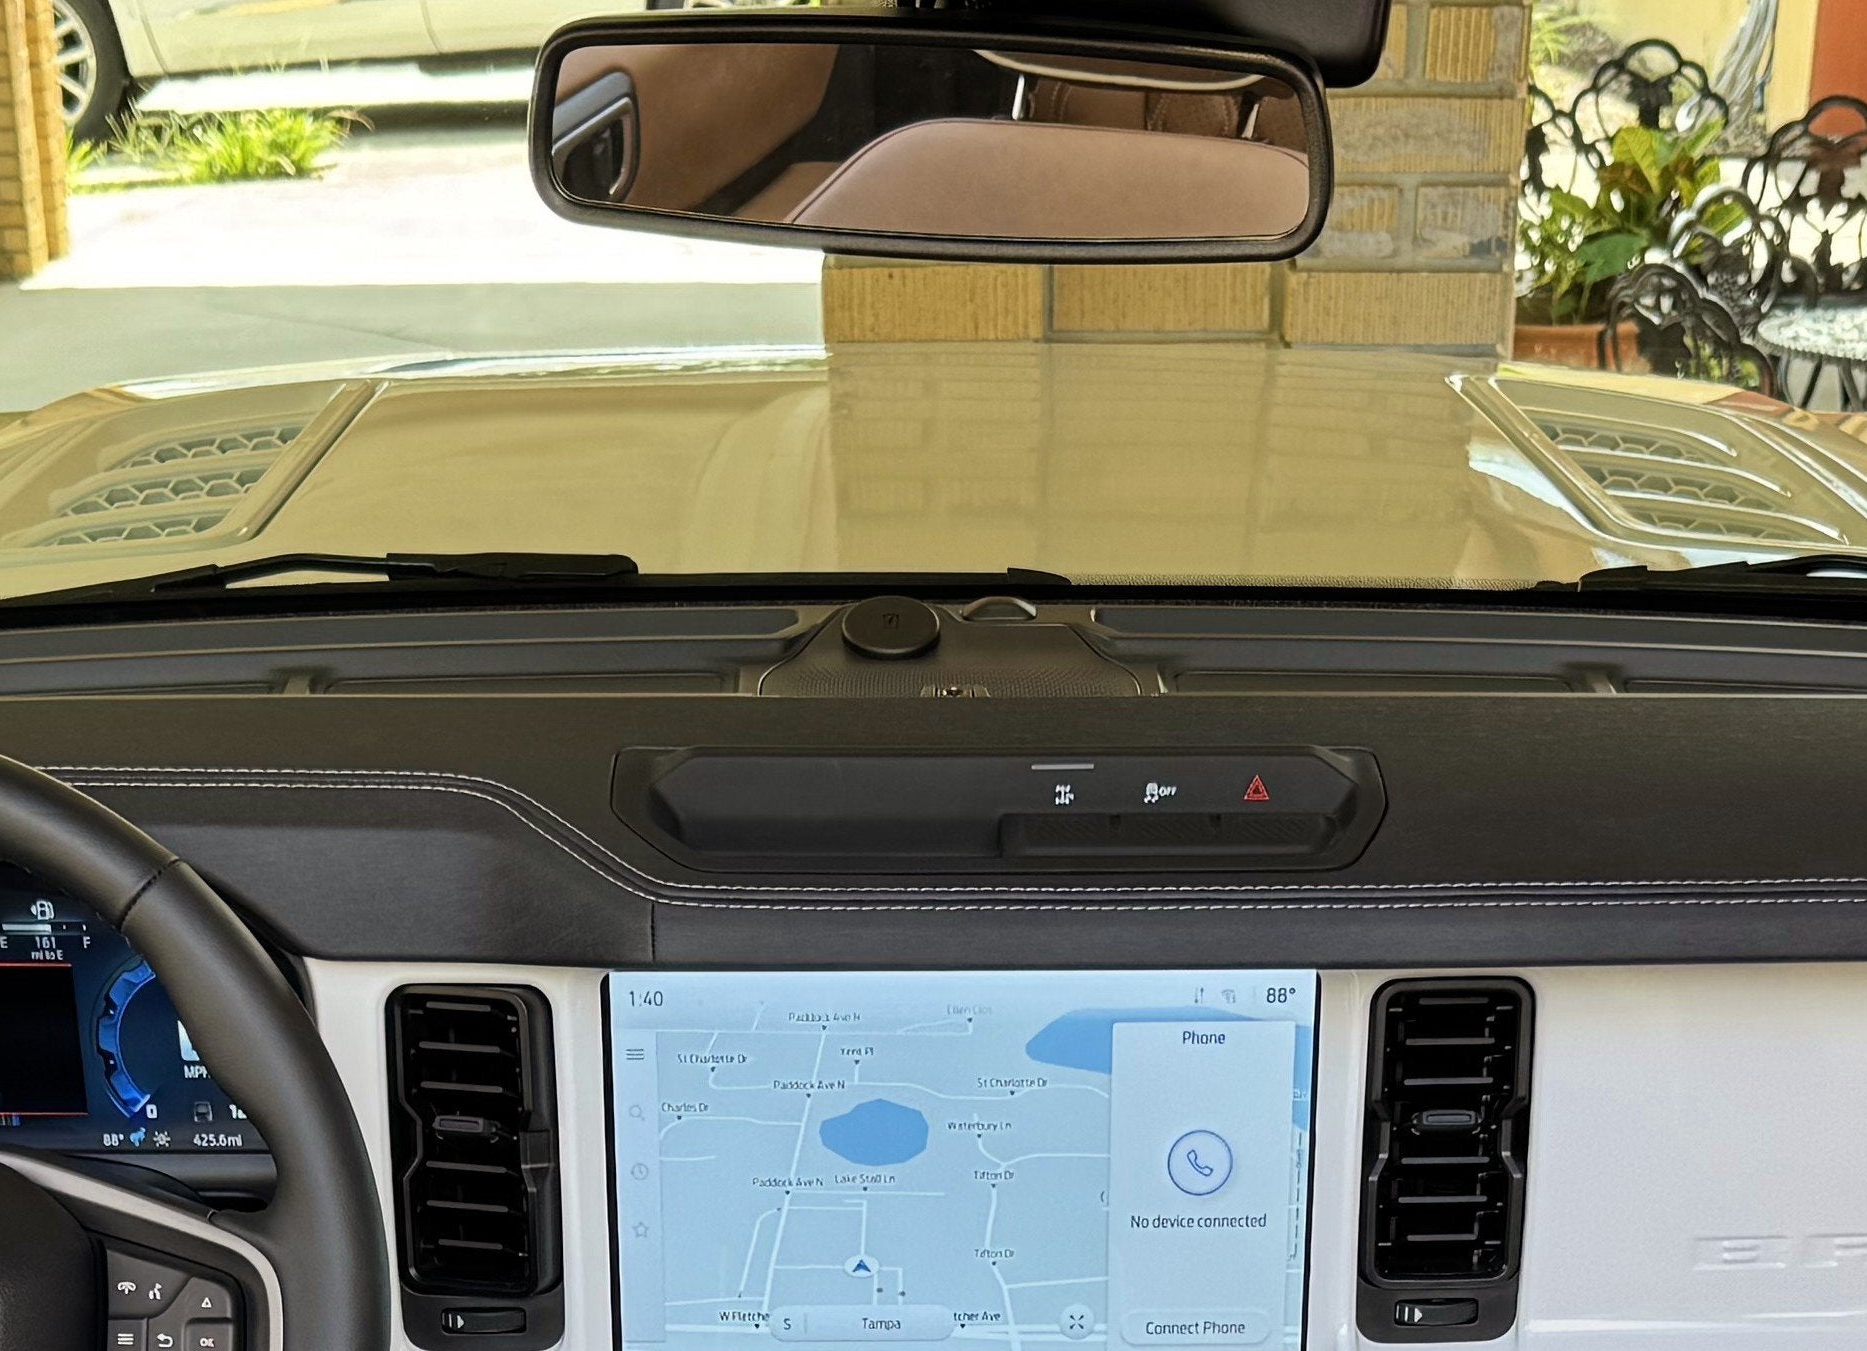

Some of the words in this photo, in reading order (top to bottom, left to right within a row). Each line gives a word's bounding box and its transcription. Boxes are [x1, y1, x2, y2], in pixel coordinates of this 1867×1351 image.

[0, 936, 8, 948] E
[628, 990, 664, 1008] 1:40
[1266, 987, 1297, 1004] 88°
[1183, 1030, 1226, 1045] Phone
[145, 1104, 158, 1119] 0
[1131, 1214, 1149, 1229] No
[1151, 1213, 1195, 1229] device
[1197, 1213, 1267, 1229] connected
[783, 1318, 792, 1331] S
[861, 1318, 902, 1332] Tampa
[1145, 1321, 1200, 1335] Connect
[1202, 1321, 1246, 1335] Phone
[199, 1337, 215, 1348] OK
